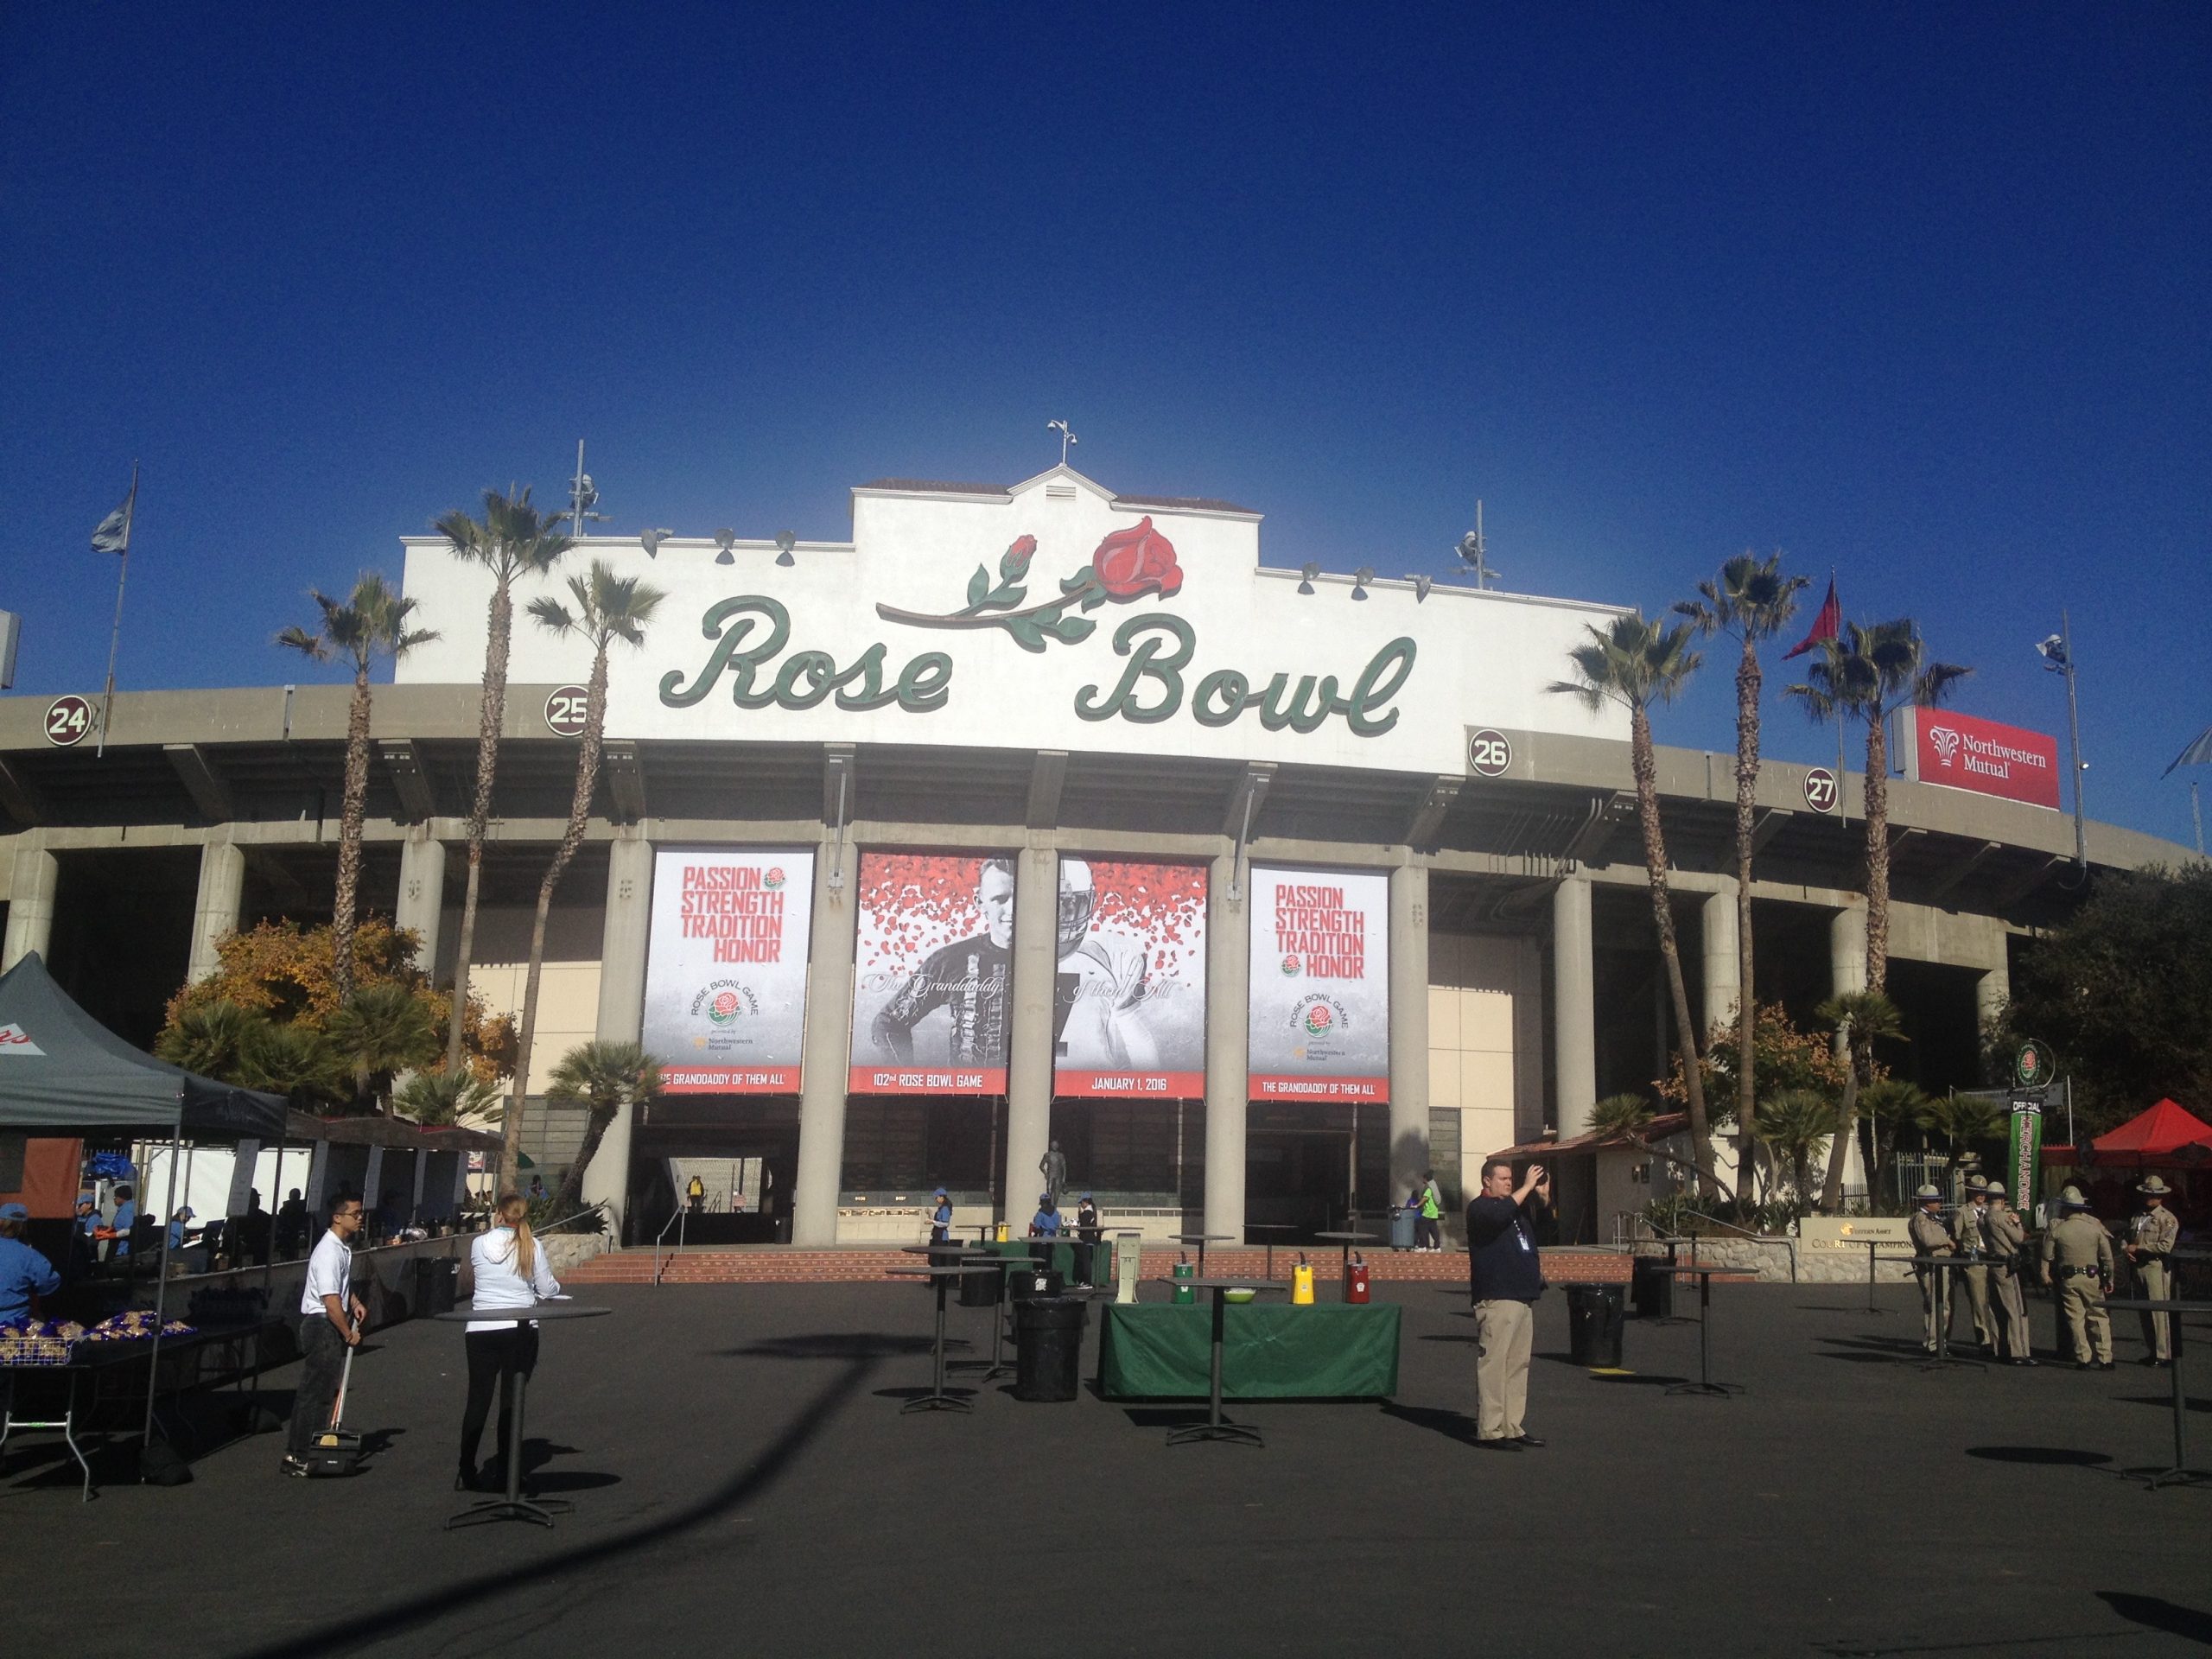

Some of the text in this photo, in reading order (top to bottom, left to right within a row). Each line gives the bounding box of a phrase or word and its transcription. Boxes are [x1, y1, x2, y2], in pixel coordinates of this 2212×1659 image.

[659, 594, 1417, 737] Rose Bowl
[49, 707, 86, 734] 24
[550, 697, 588, 723] 25
[1474, 740, 1507, 766] 26
[1962, 734, 2047, 768] Northwestern
[1963, 753, 2010, 779] Mutual
[1808, 778, 1834, 802] 27
[683, 866, 761, 891] PASSION
[681, 890, 784, 914] STRENGTH
[1275, 884, 1343, 910] PASSION
[681, 914, 783, 938] TRADITION
[1275, 907, 1364, 933] STRENGTH
[714, 938, 781, 963] HONOR
[1275, 931, 1364, 957] TRADITION
[1306, 954, 1365, 979] HONOR
[691, 979, 759, 1015] ROSE BOWL GAME
[907, 973, 1004, 999] Granddaddy
[1290, 993, 1348, 1028] ROSE BOWL GAME
[673, 1074, 729, 1085] GRANDDADDY
[732, 1074, 743, 1085] OF
[746, 1074, 767, 1085] THEM
[769, 1074, 785, 1085] ALL
[874, 1073, 982, 1088] 102nd ROSE BOWL GAME
[1091, 1077, 1167, 1091] JANUARY 1, 2016
[1262, 1082, 1375, 1096] THE GRANDDADDY OF THEM ALL
[2017, 1115, 2033, 1211] MERCHANDISE
